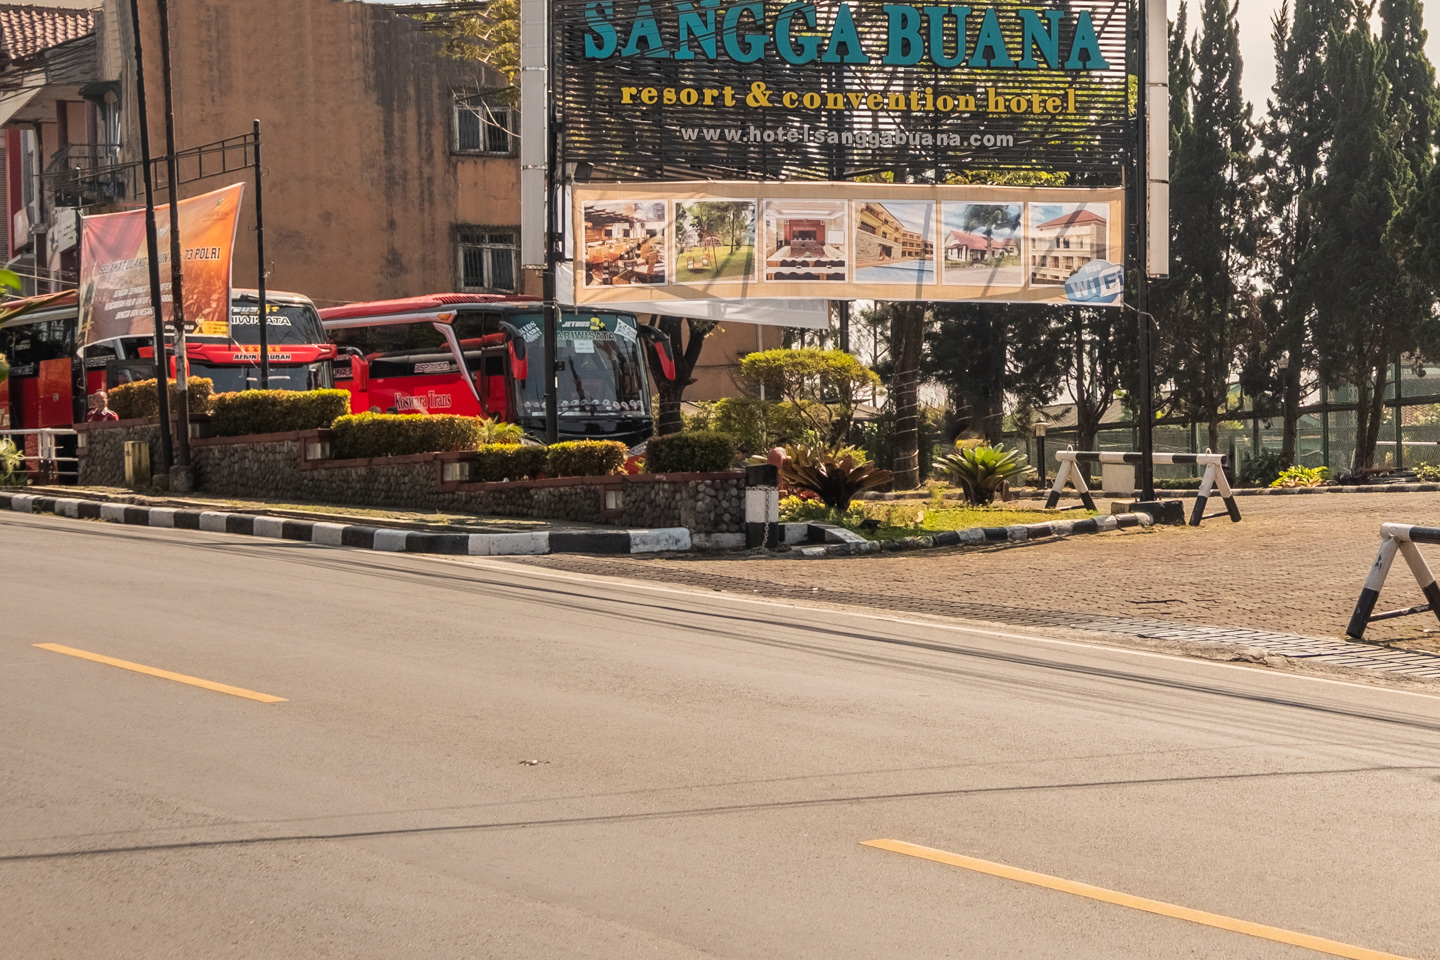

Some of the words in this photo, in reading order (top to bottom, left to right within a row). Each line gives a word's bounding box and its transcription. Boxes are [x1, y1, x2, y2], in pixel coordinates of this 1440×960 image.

[882, 3, 1110, 70] BUANA
[620, 85, 736, 107] resort
[746, 81, 773, 108] &
[782, 87, 977, 112] convention
[986, 88, 1077, 114] hotel
[681, 125, 1014, 148] www.hotelsanggabuana.com
[184, 249, 193, 260] 73
[194, 247, 221, 259] POLRI
[556, 330, 617, 341] ARIWISATA
[428, 390, 452, 408] Trans
